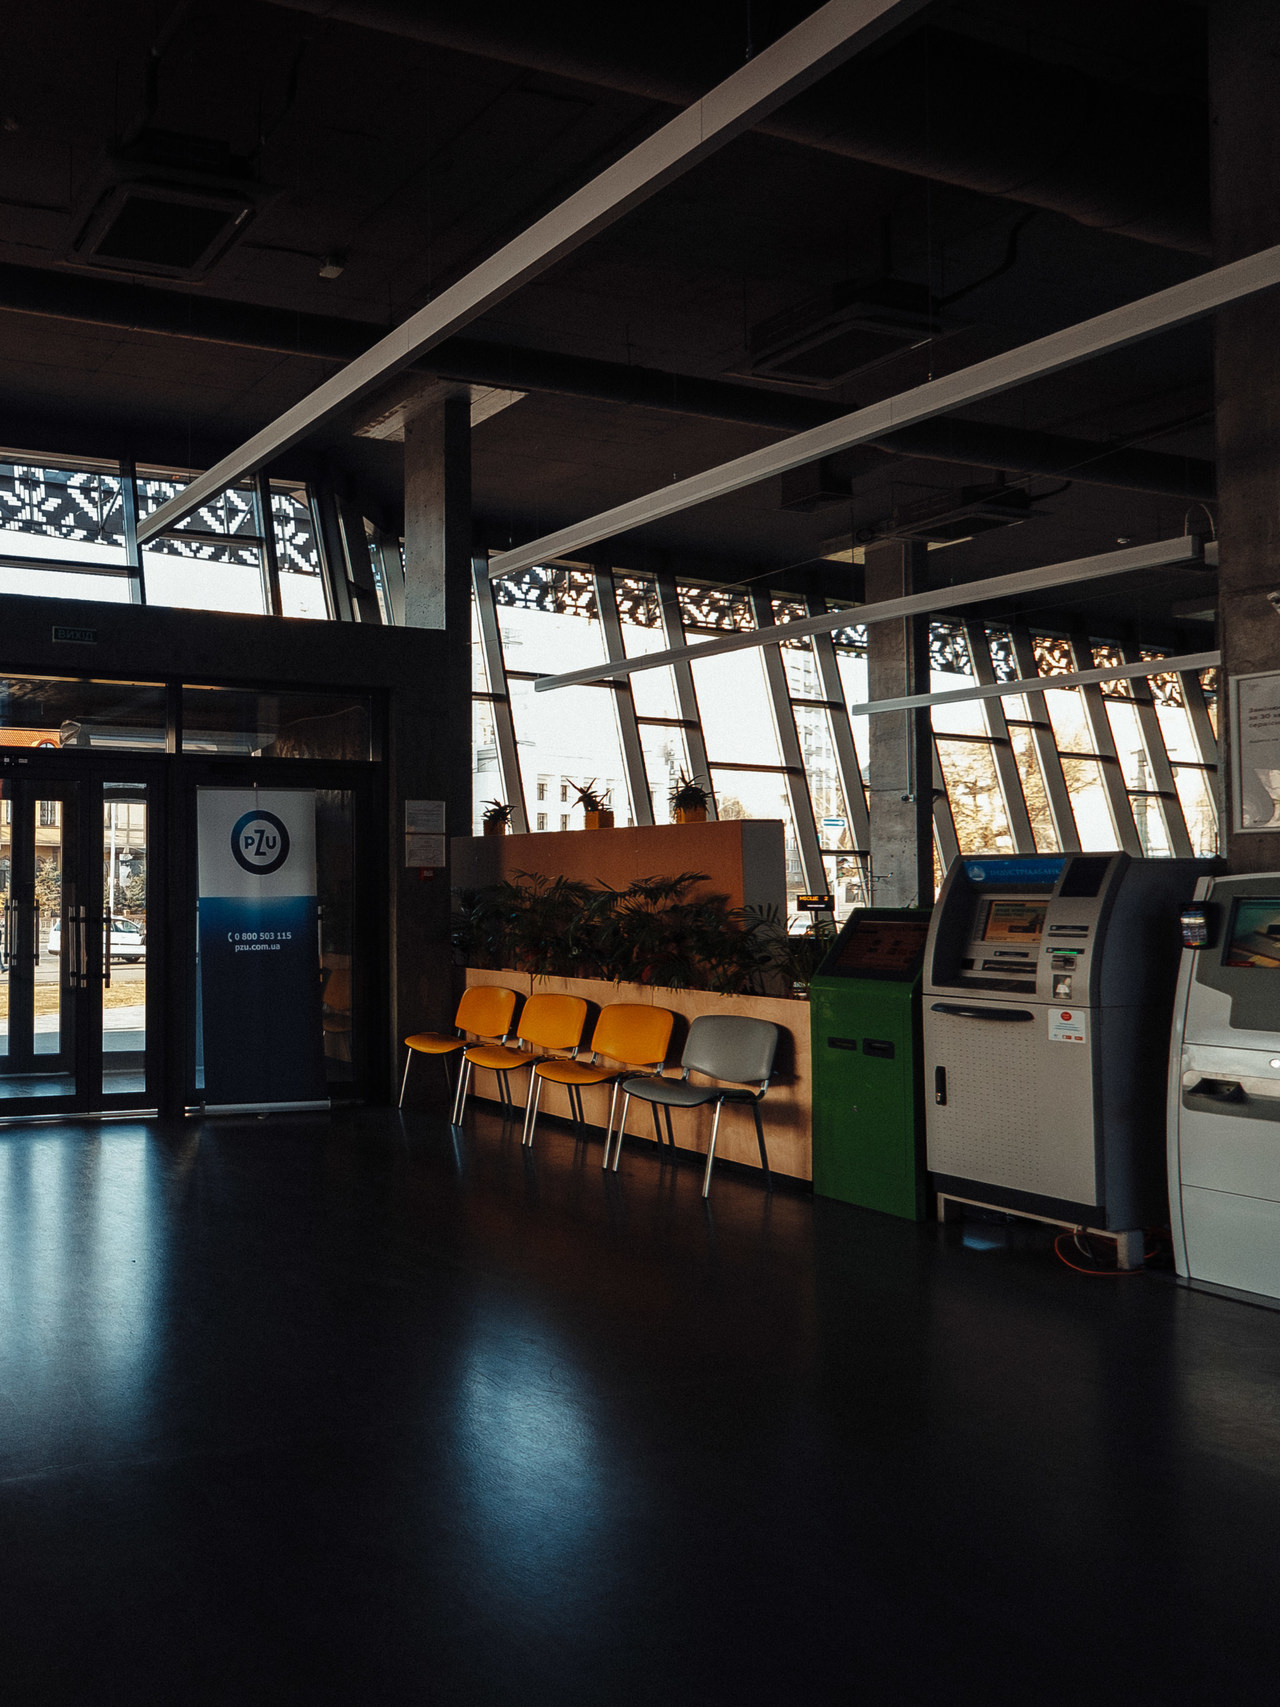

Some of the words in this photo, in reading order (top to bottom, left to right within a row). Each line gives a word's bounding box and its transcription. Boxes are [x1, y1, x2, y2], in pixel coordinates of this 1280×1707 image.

[57, 629, 94, 642] ВИХІД
[234, 932, 240, 941] 0
[241, 932, 258, 941] 800
[259, 932, 275, 941] 503
[276, 931, 292, 940] 115
[234, 943, 281, 952] pzu.com.ua
